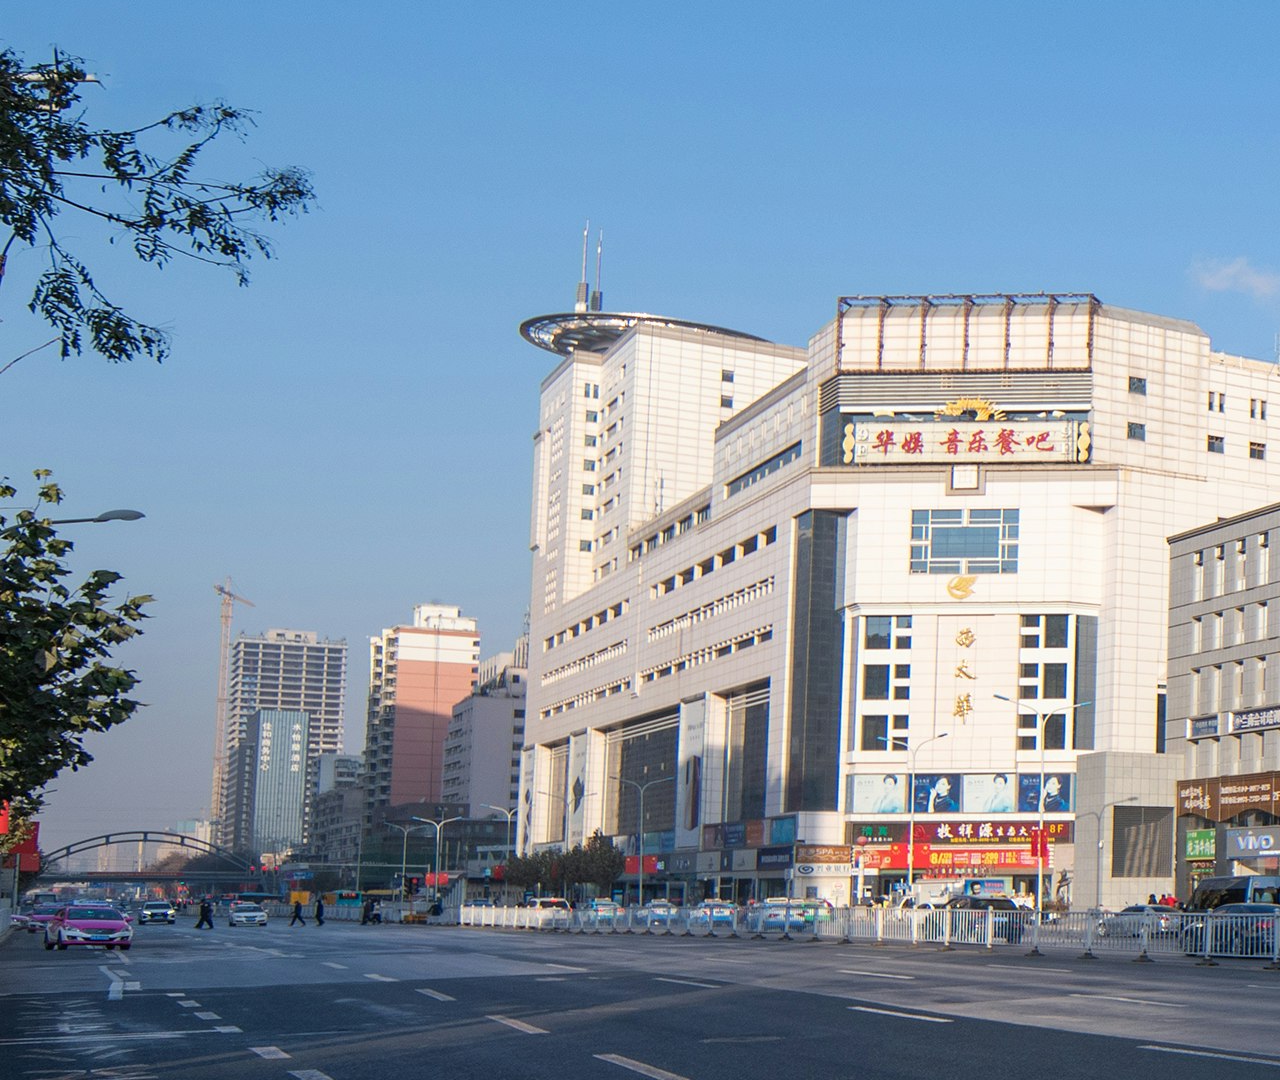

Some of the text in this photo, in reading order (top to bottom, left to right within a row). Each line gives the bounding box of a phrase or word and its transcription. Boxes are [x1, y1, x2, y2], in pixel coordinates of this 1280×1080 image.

[939, 428, 1055, 456] 音乐餐吧
[1237, 831, 1274, 850] vivo
